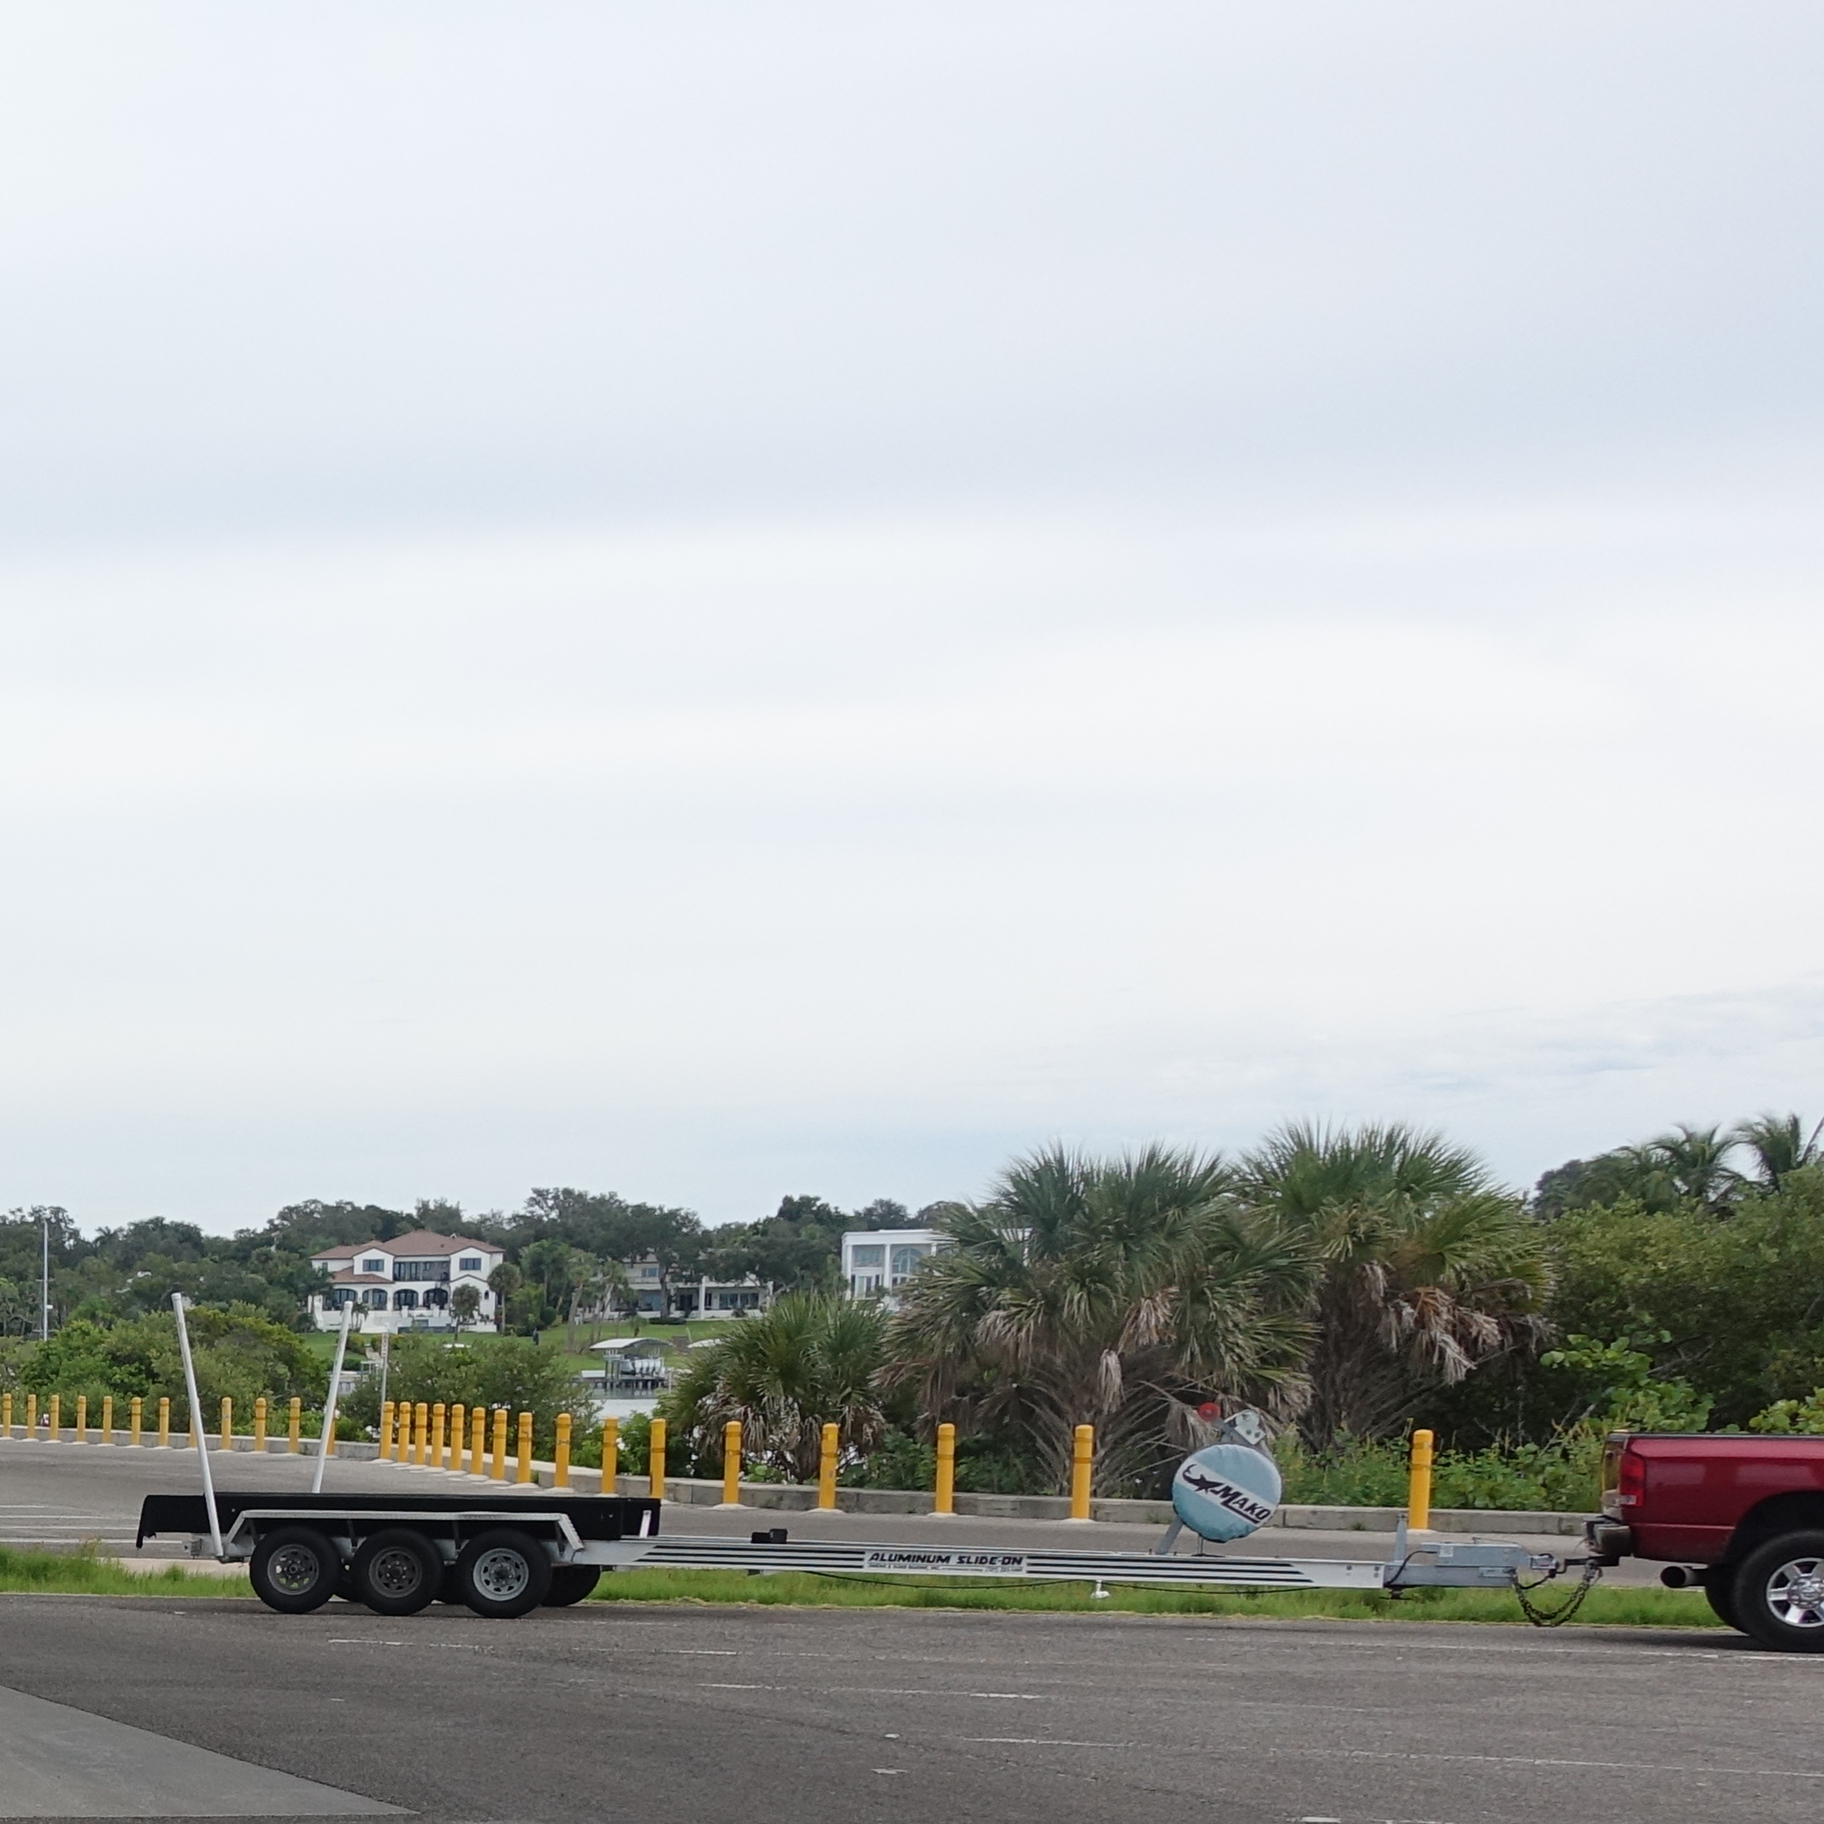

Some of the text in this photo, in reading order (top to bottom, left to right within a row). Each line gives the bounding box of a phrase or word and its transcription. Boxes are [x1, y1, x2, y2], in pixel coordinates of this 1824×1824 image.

[1210, 1485, 1271, 1524] MAKO
[869, 1553, 1023, 1566] ALUMINUM SLIDE-ON
